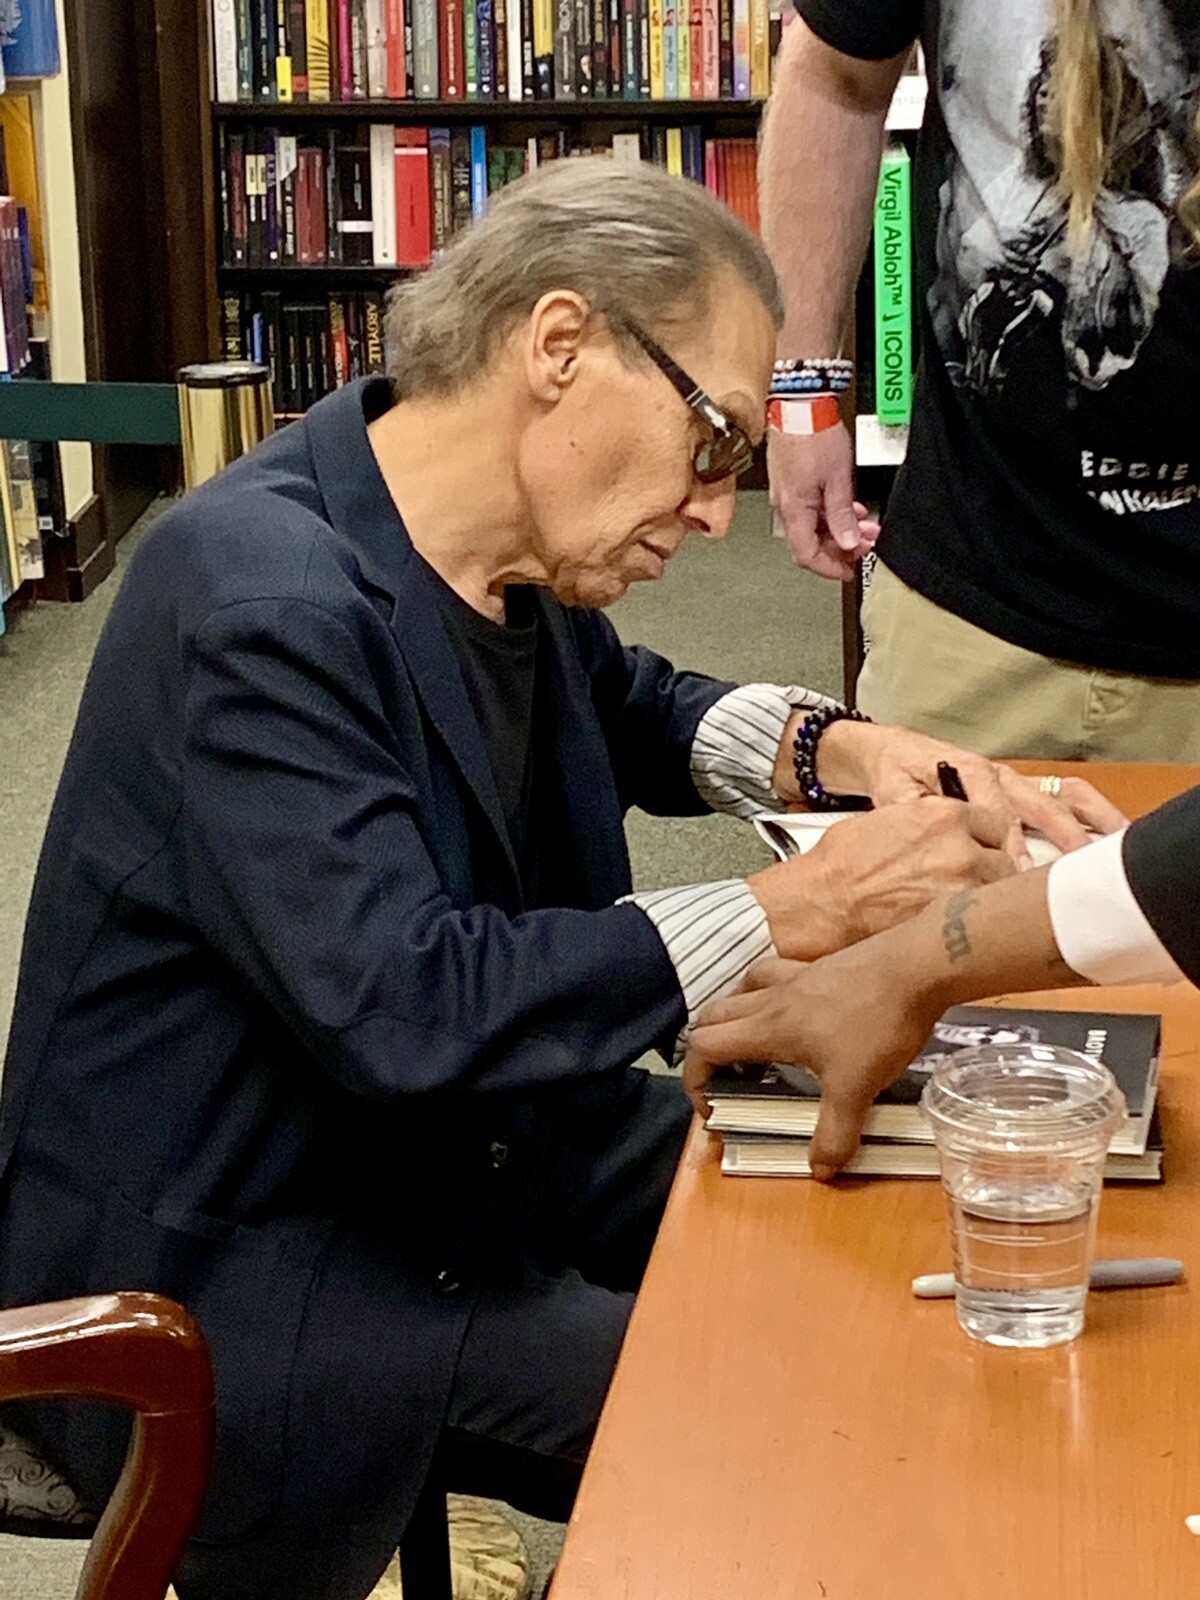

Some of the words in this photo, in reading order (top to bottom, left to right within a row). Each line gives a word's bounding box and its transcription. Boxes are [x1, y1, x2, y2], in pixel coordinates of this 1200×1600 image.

[878, 167, 902, 221] Virgil
[883, 330, 904, 402] ICONS
[1081, 450, 1189, 480] EDDIE
